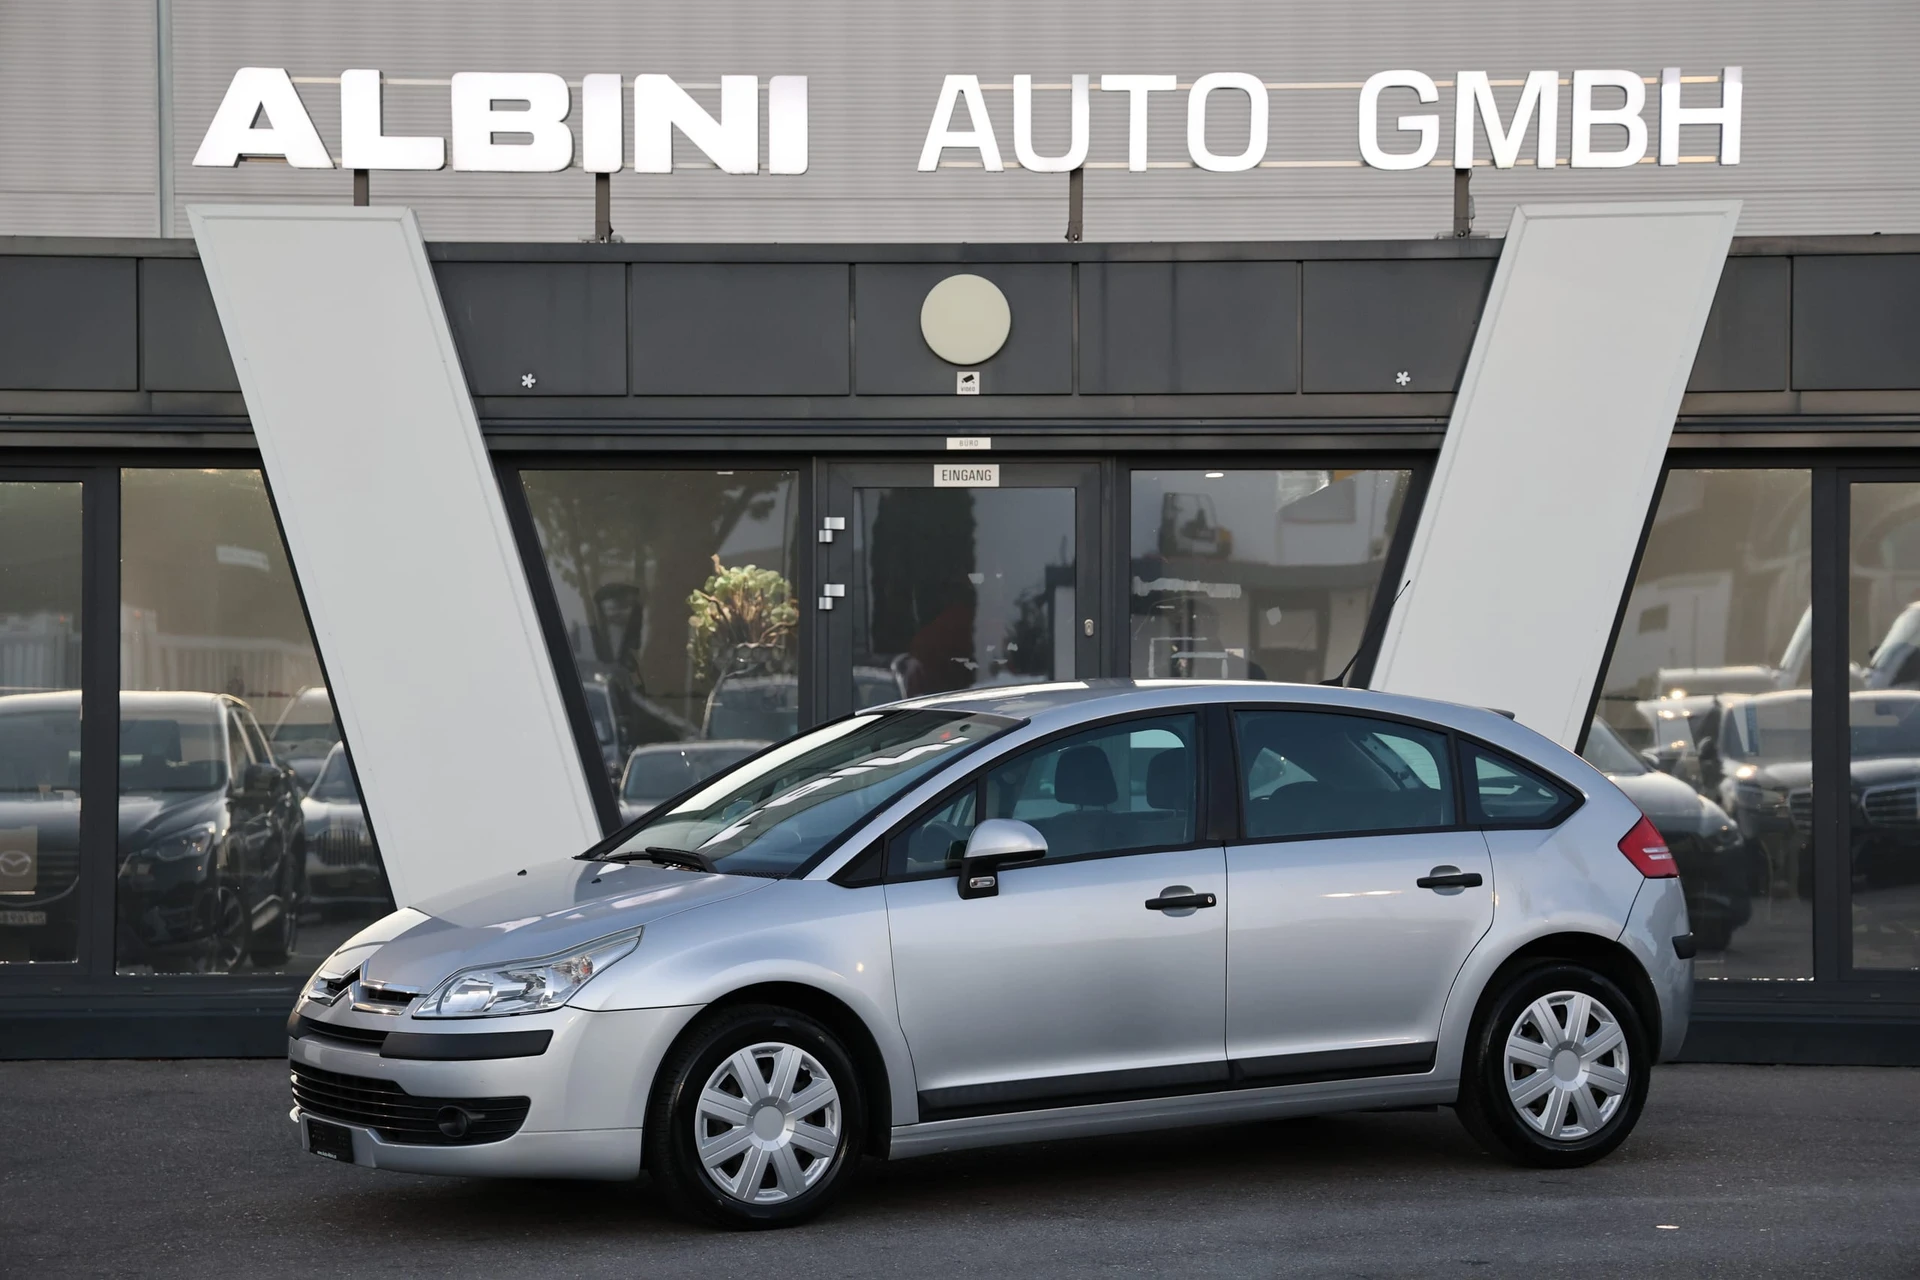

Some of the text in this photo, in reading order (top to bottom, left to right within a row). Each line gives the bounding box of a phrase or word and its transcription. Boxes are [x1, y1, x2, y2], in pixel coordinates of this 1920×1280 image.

[191, 66, 1743, 174] ALBINI AUTO GMBH
[942, 469, 992, 482] EINGANG
